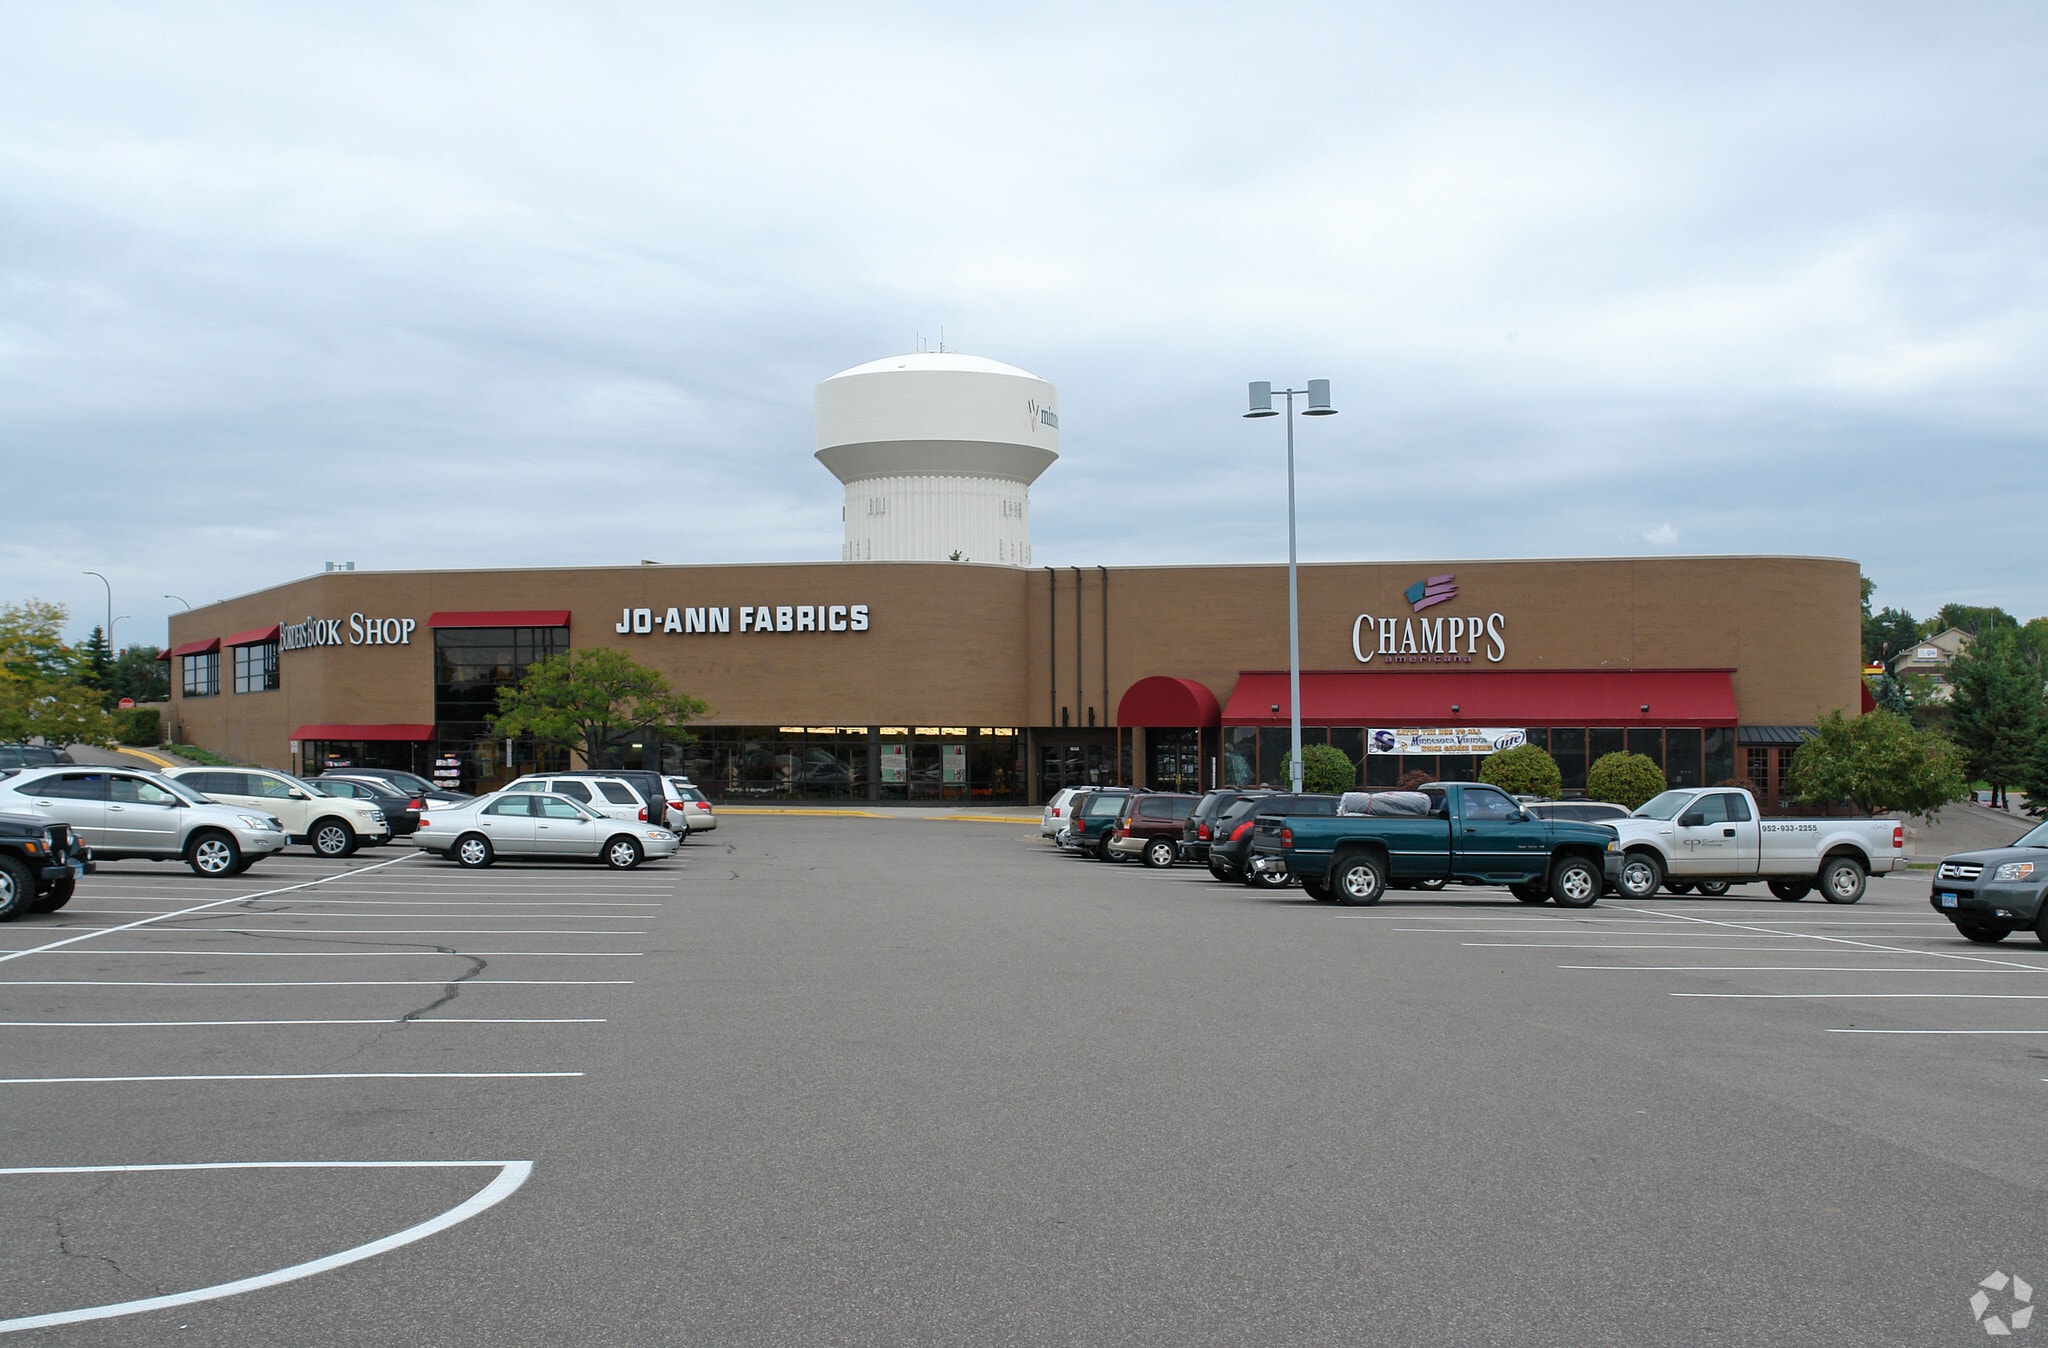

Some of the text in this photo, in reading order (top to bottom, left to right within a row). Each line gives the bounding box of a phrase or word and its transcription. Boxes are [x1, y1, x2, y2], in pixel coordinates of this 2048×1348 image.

[279, 612, 416, 651] BORDERS BOOK SHOP
[615, 604, 870, 633] JO-ANN FABRICS
[1352, 613, 1505, 662] CHAMPPS
[1384, 655, 1472, 663] americana
